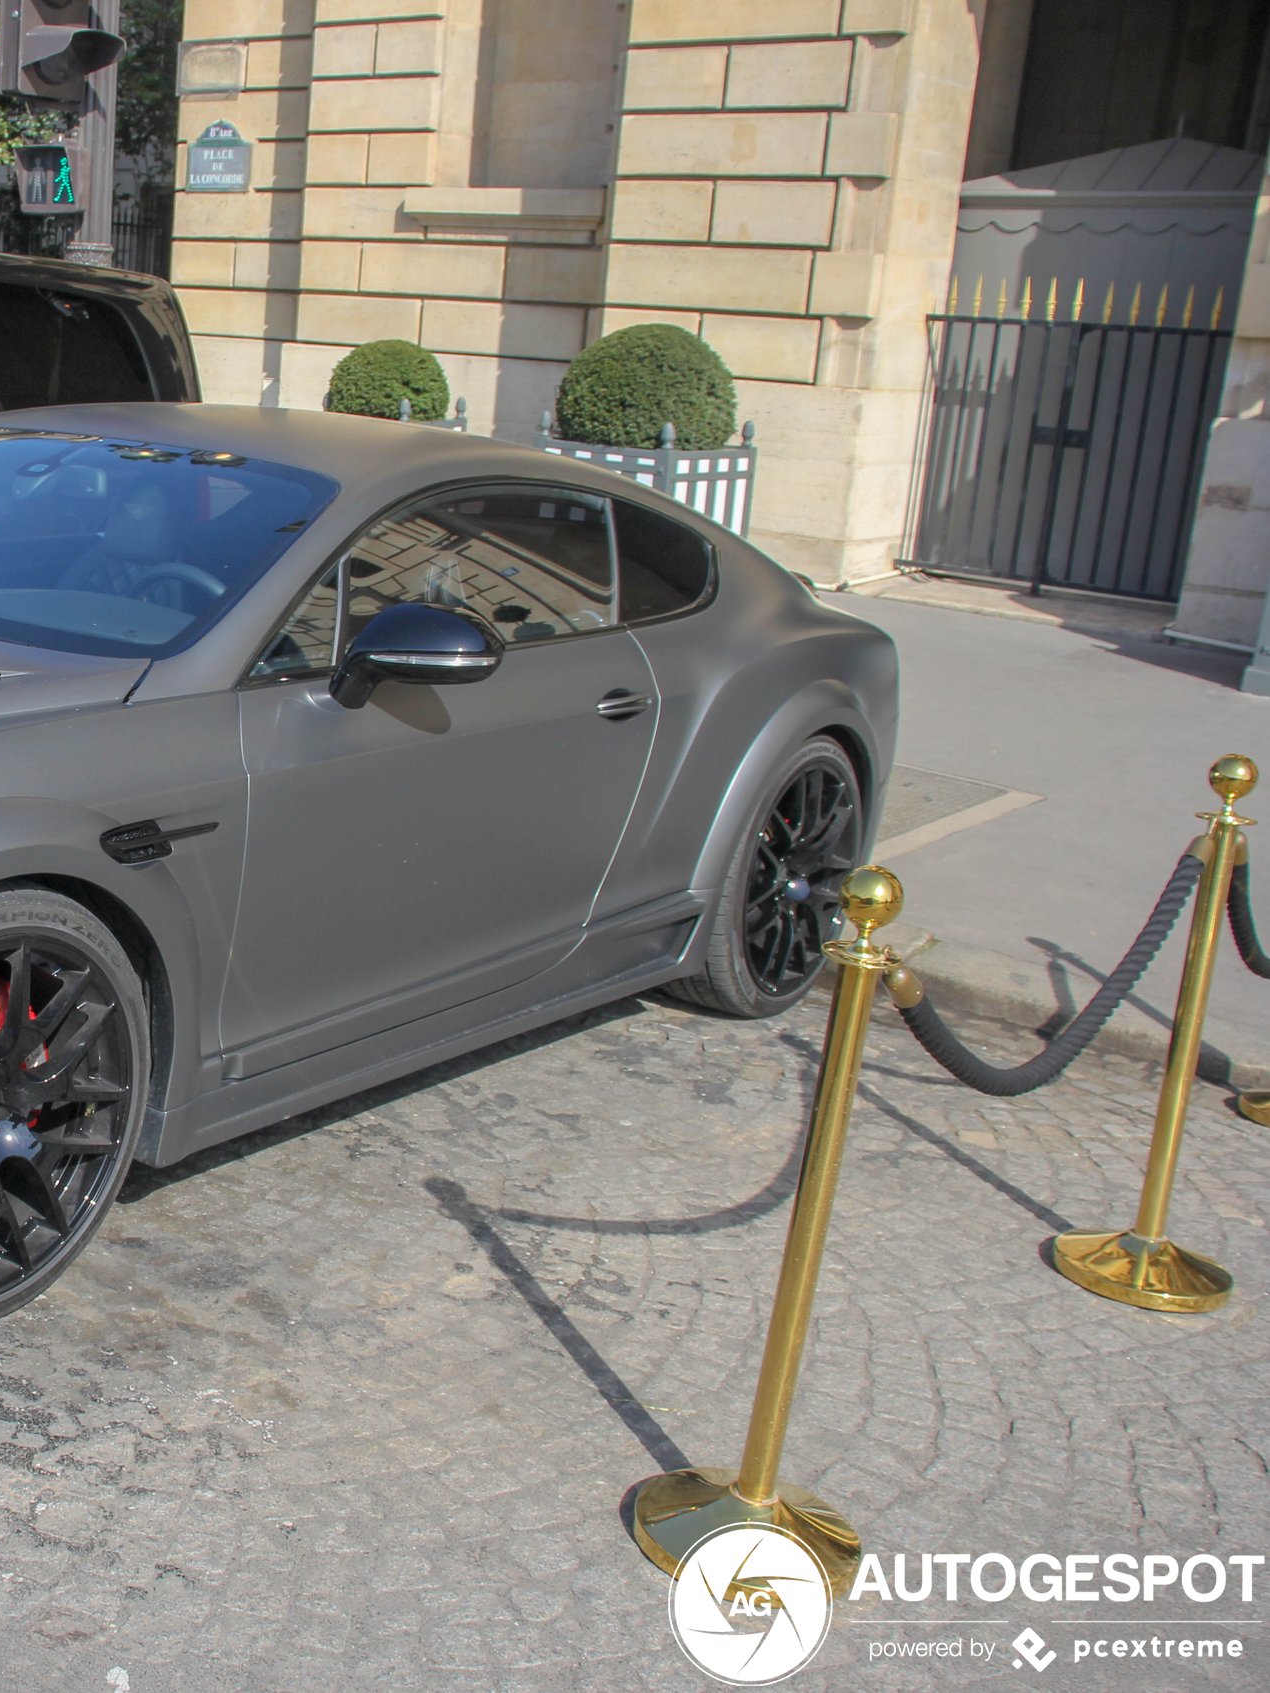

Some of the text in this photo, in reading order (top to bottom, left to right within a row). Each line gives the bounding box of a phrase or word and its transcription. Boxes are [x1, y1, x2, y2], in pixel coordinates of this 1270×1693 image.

[203, 149, 234, 160] PLACE
[212, 162, 224, 171] DE
[190, 173, 245, 184] LA CONCORDE
